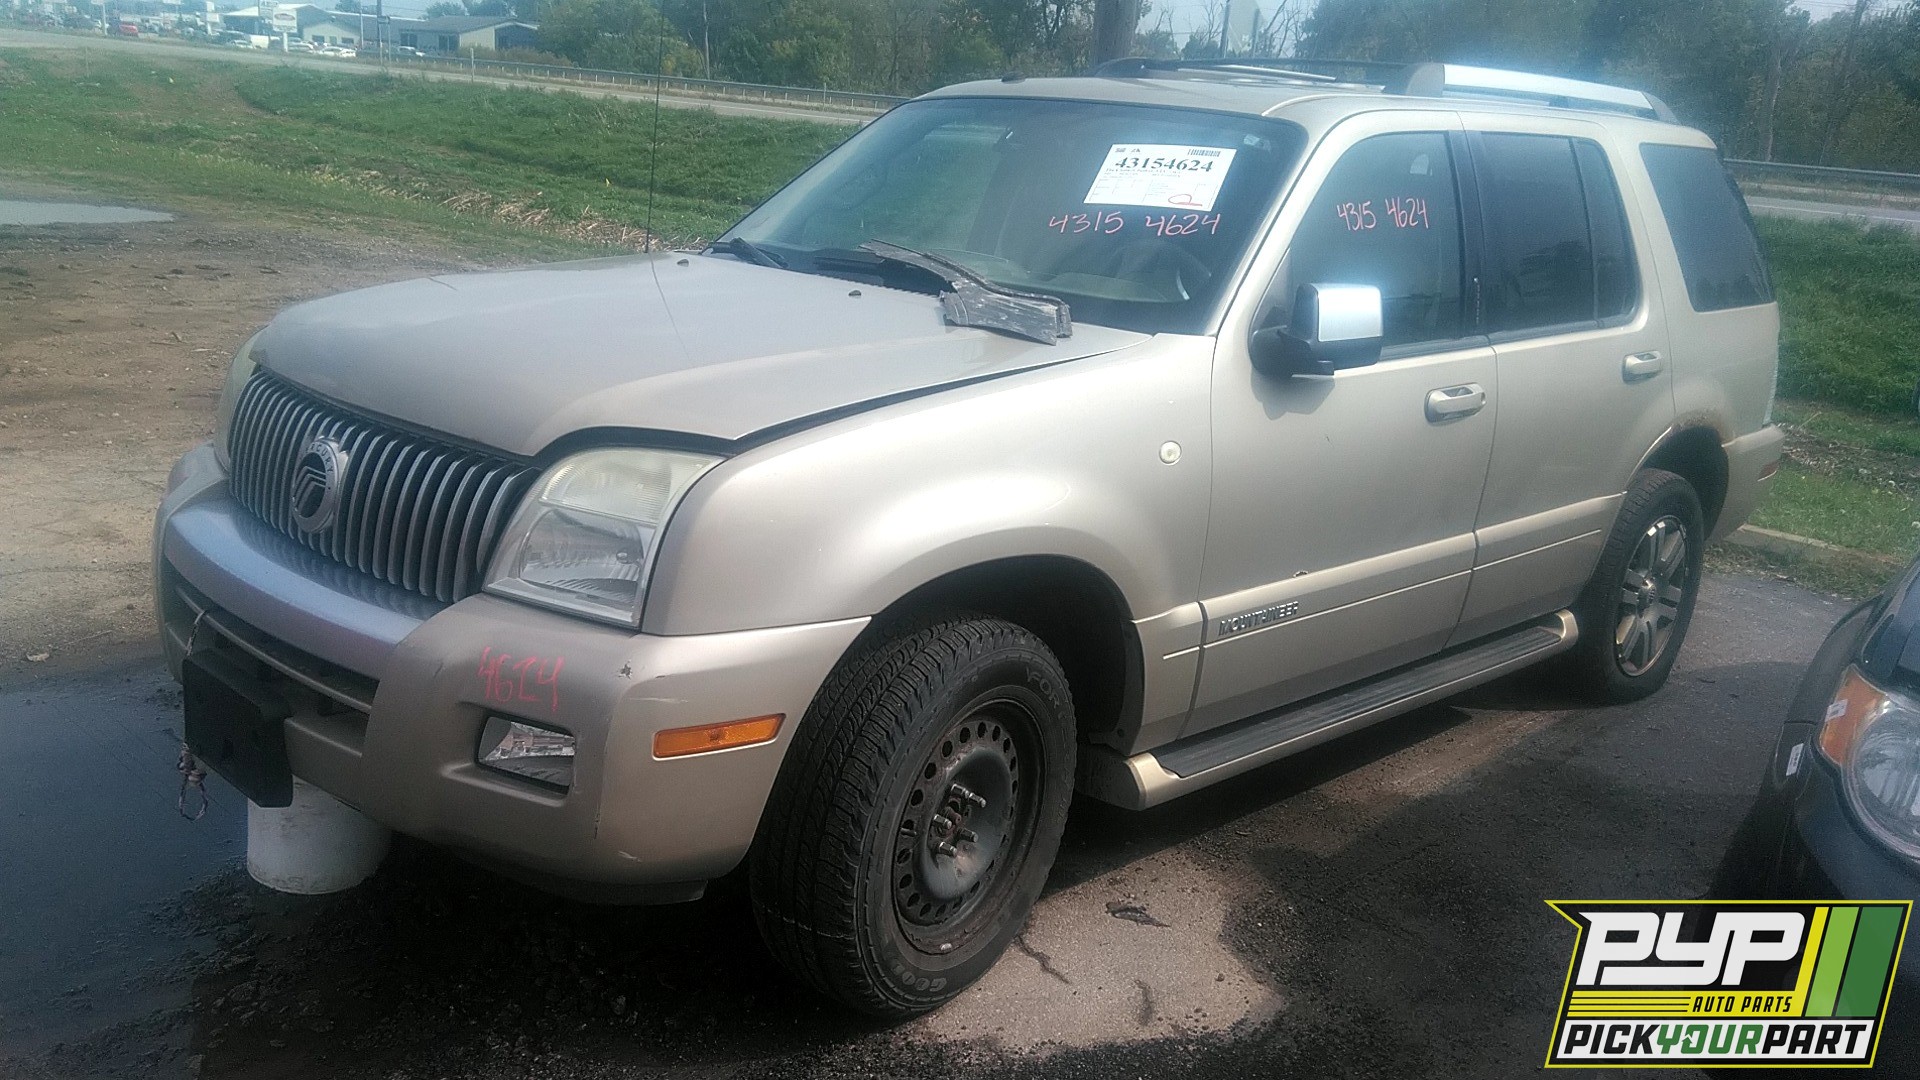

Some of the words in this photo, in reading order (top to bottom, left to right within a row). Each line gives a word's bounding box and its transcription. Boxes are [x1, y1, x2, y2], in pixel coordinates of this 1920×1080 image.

[1115, 156, 1214, 173] 43154624
[1049, 210, 1124, 235] 4315
[1145, 212, 1221, 237] 4624
[1337, 200, 1377, 231] 4315
[1384, 196, 1429, 229] 4624
[476, 645, 566, 713] 4624
